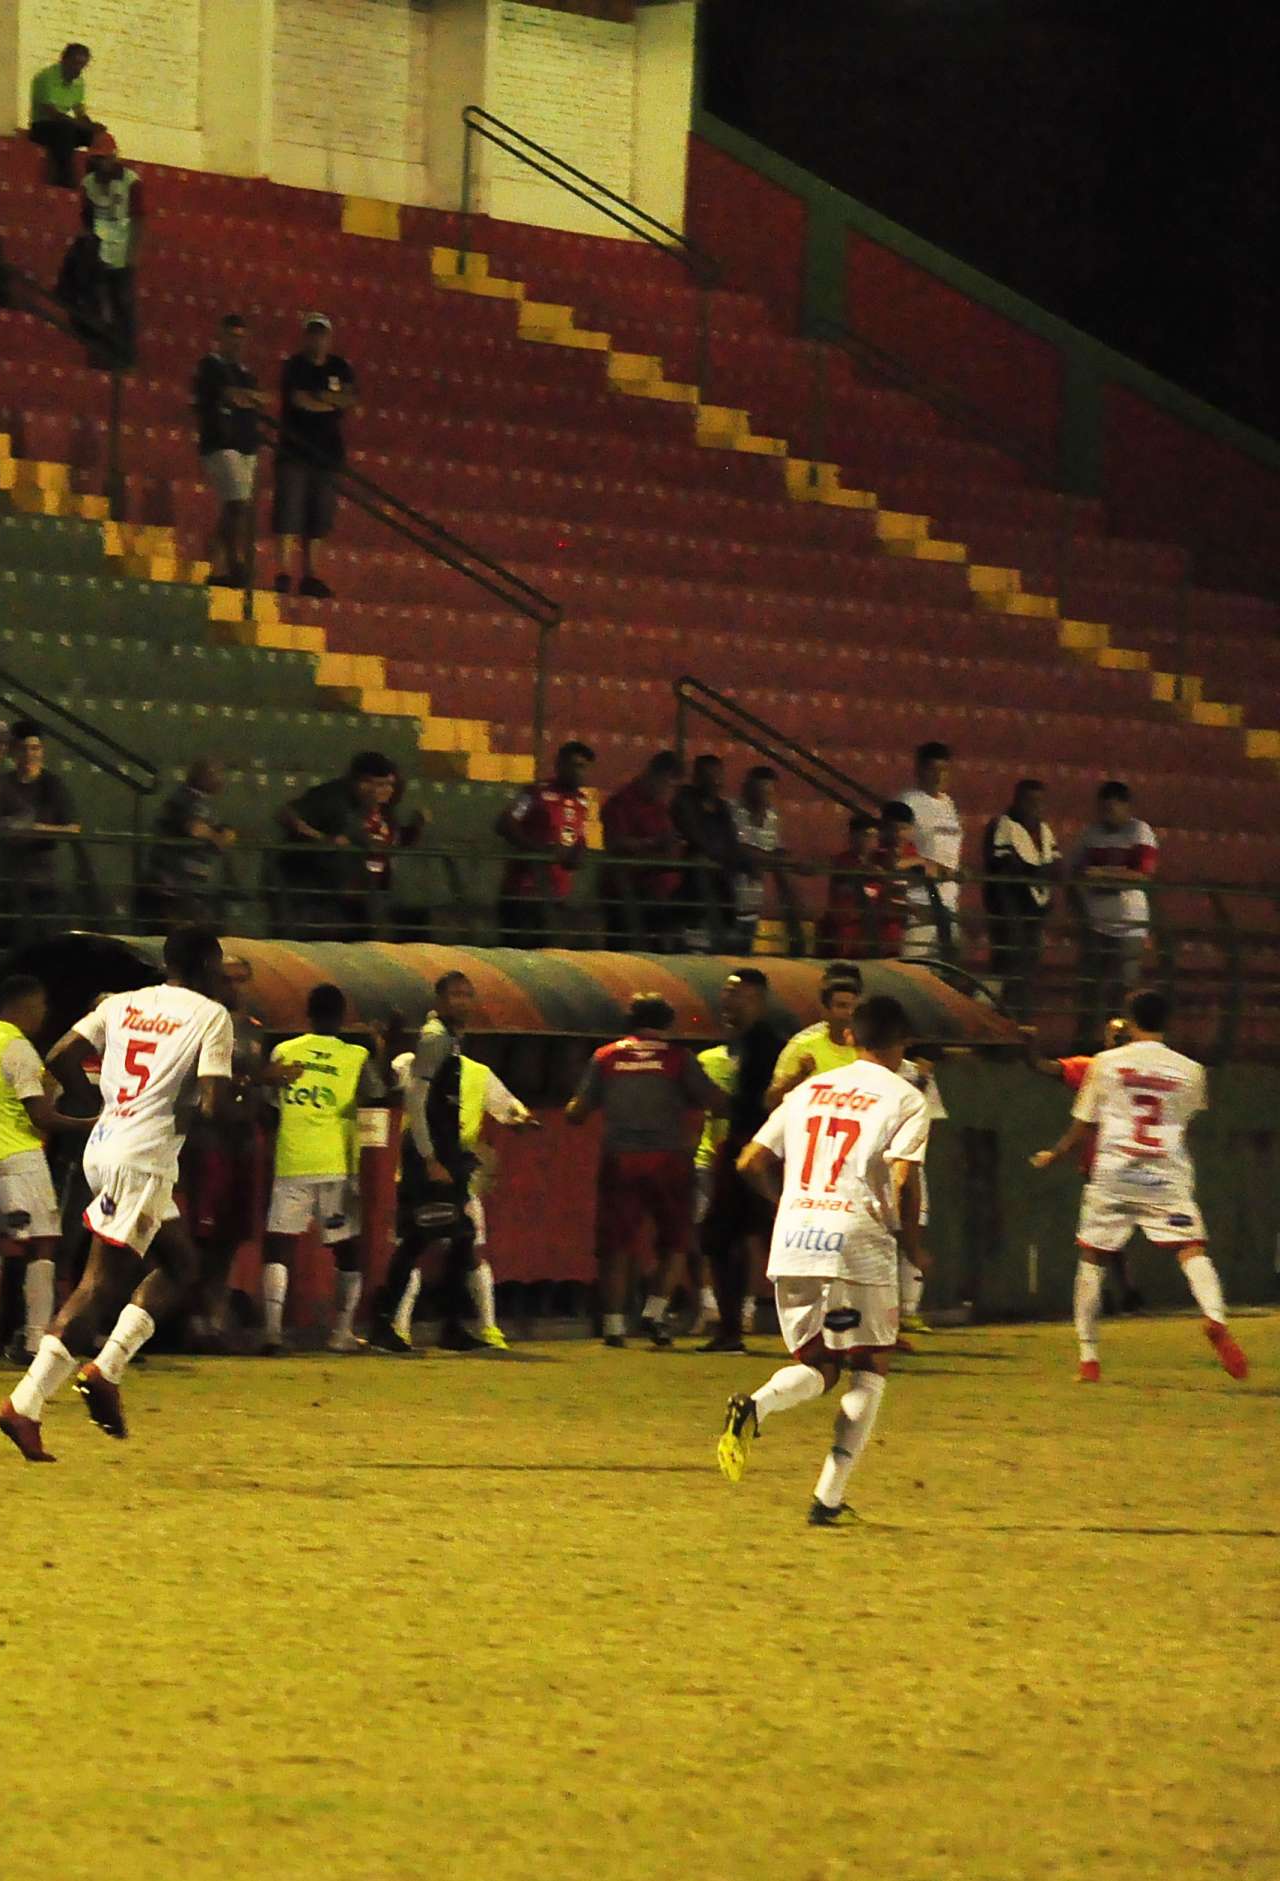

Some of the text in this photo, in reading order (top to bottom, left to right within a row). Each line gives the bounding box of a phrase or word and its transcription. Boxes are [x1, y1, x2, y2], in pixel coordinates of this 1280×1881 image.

[121, 1005, 181, 1035] Tudor
[117, 1039, 157, 1104] 5
[808, 1084, 881, 1112] Tudor
[1132, 1094, 1163, 1147] 2
[800, 1115, 861, 1193] 17
[785, 1222, 845, 1253] vitta
